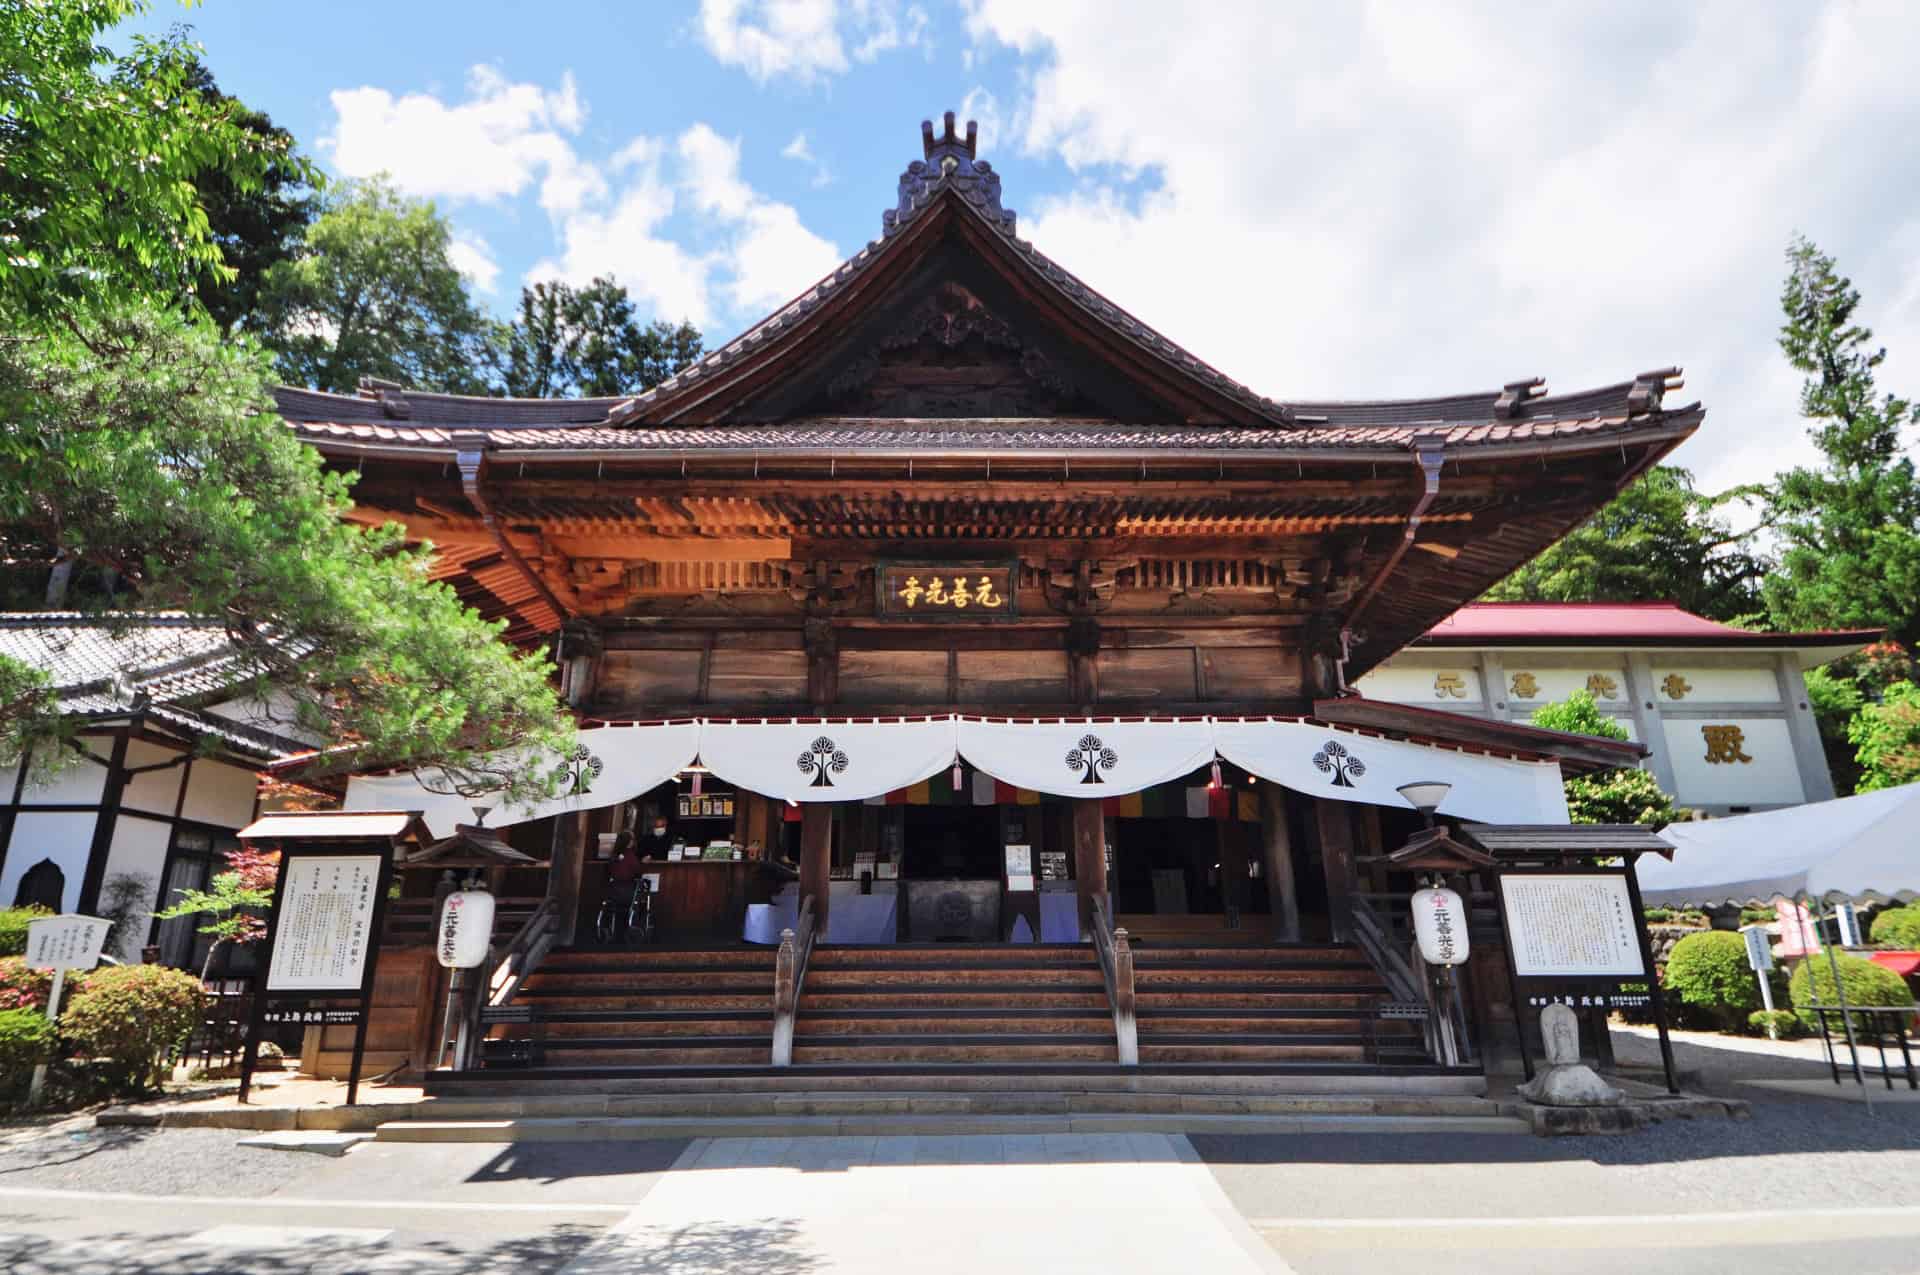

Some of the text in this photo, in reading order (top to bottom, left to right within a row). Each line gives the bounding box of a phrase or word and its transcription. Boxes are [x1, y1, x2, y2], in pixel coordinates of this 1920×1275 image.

[1701, 725, 1753, 764] 殿
[1434, 908, 1456, 960] 元善光寺
